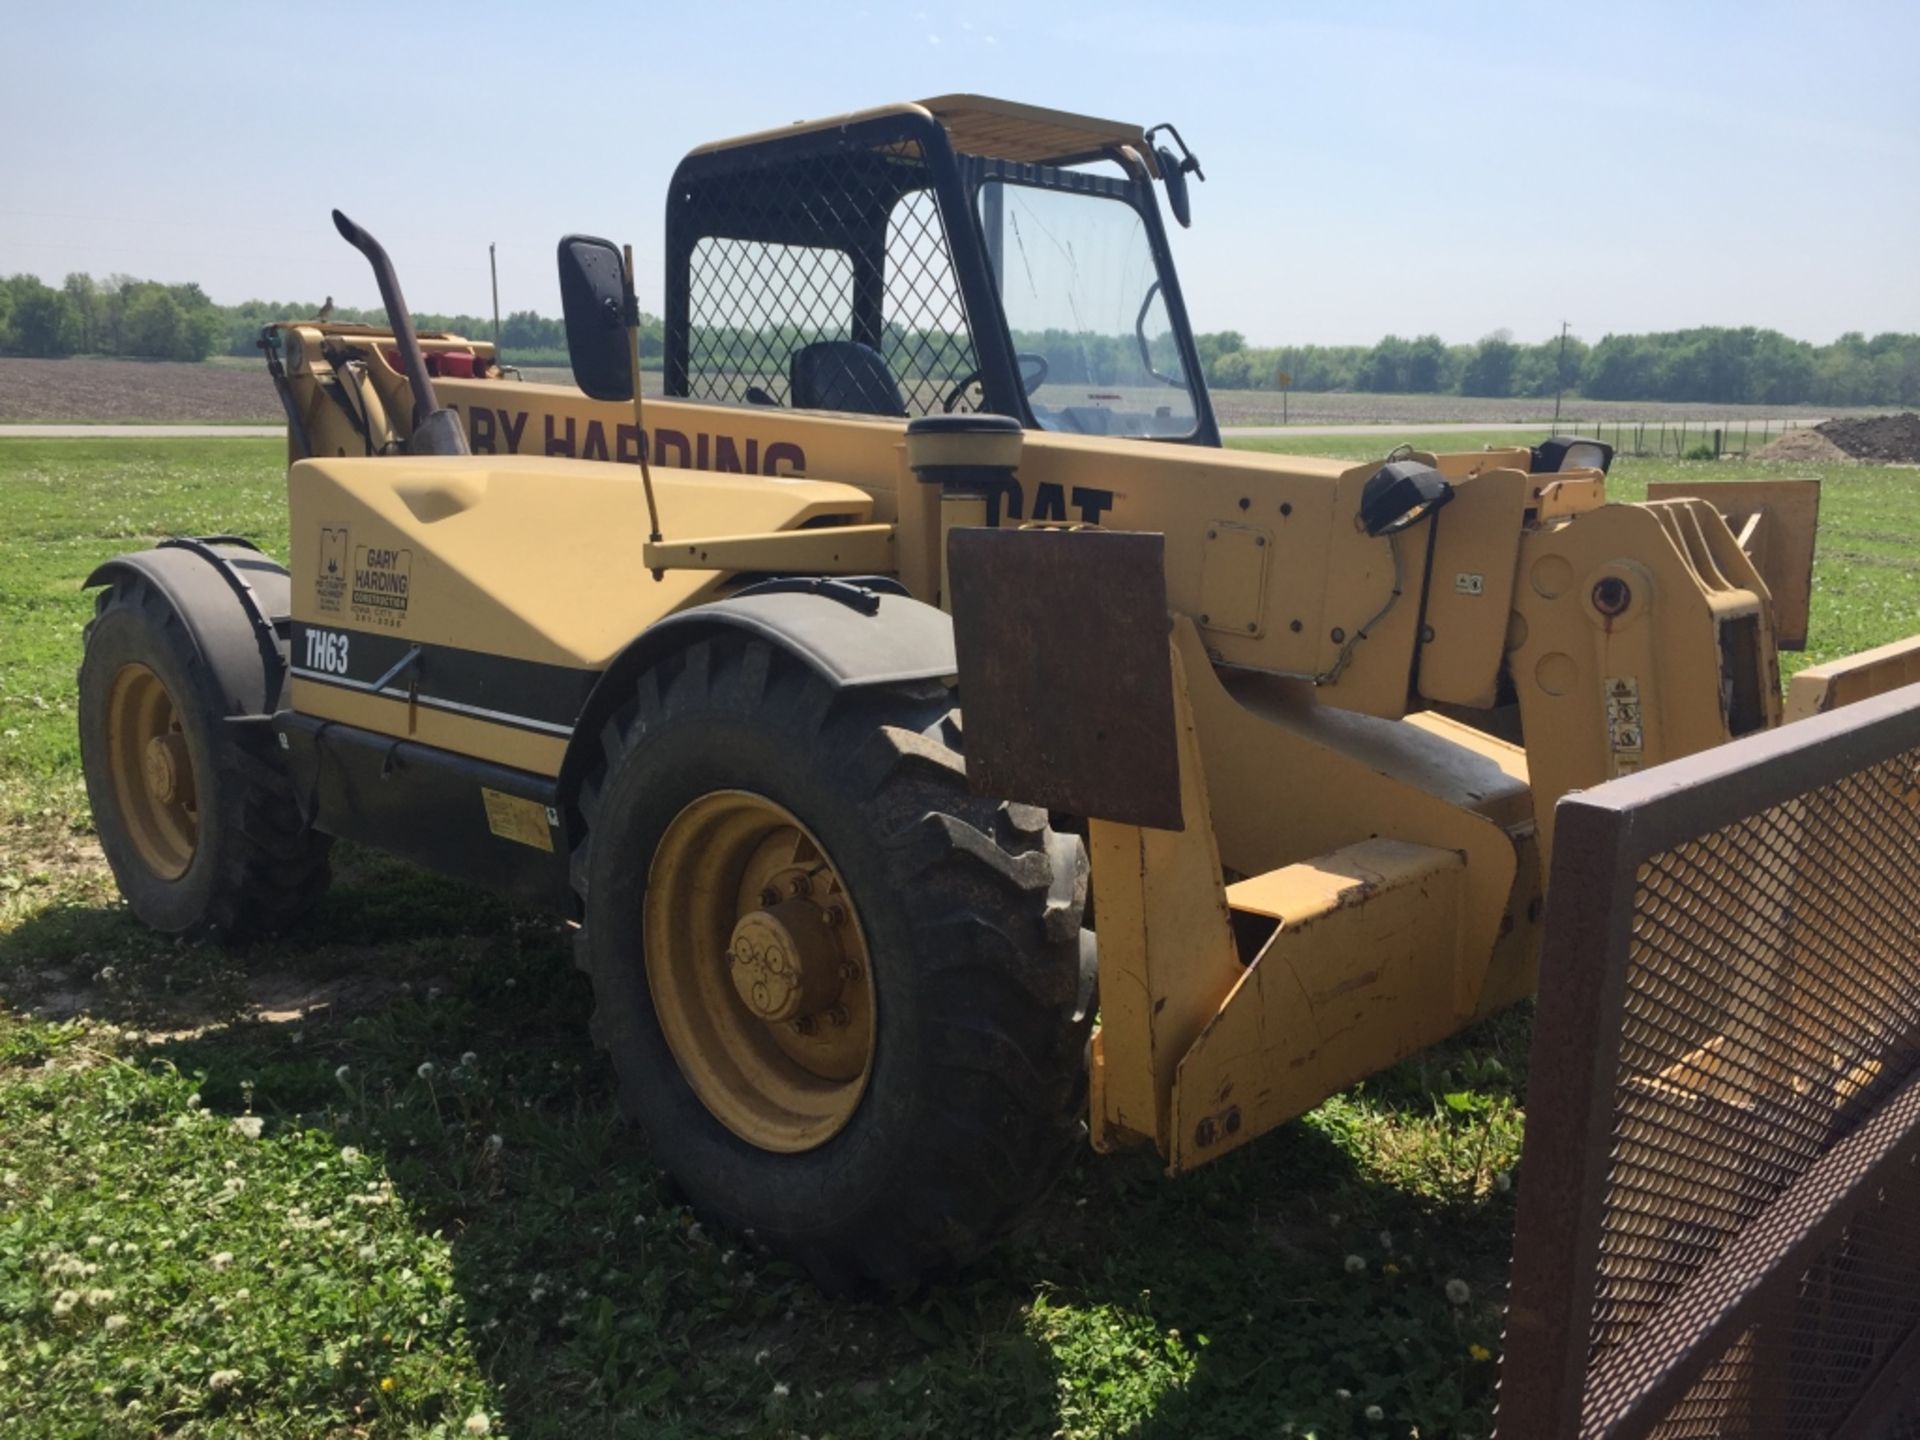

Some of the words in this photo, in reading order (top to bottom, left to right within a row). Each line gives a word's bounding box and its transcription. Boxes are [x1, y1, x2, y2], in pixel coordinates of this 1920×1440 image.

[367, 548, 399, 571] GARY
[355, 569, 408, 594] HARDING
[305, 628, 349, 674] TH63
